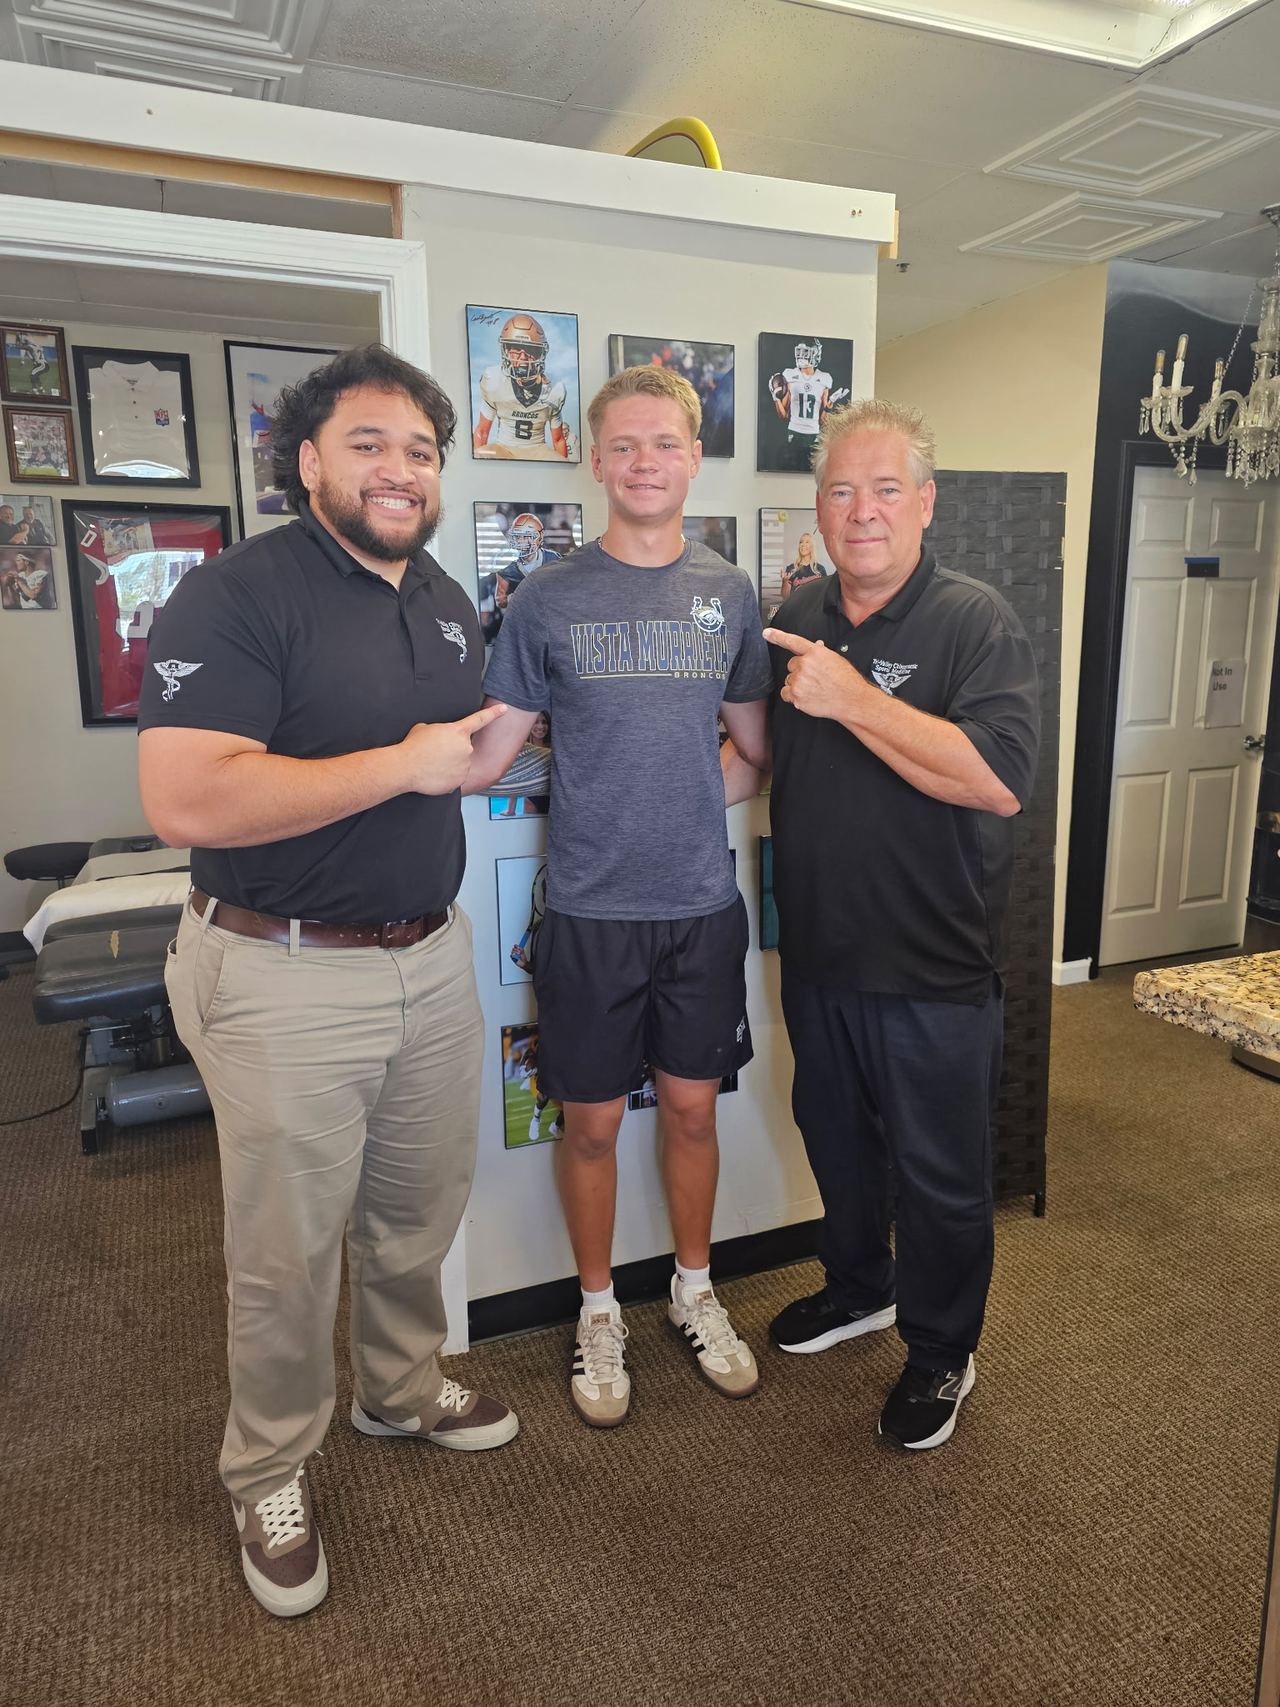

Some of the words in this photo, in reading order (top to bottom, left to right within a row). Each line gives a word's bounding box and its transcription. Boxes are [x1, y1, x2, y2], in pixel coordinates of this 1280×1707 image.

[798, 393, 817, 419] 13
[511, 410, 539, 419] BRONCOS
[515, 420, 533, 440] 8
[570, 621, 634, 674] VISTA
[636, 620, 729, 674] MURRIETA
[674, 671, 726, 680] BRONCOS
[1212, 681, 1228, 691] Use
